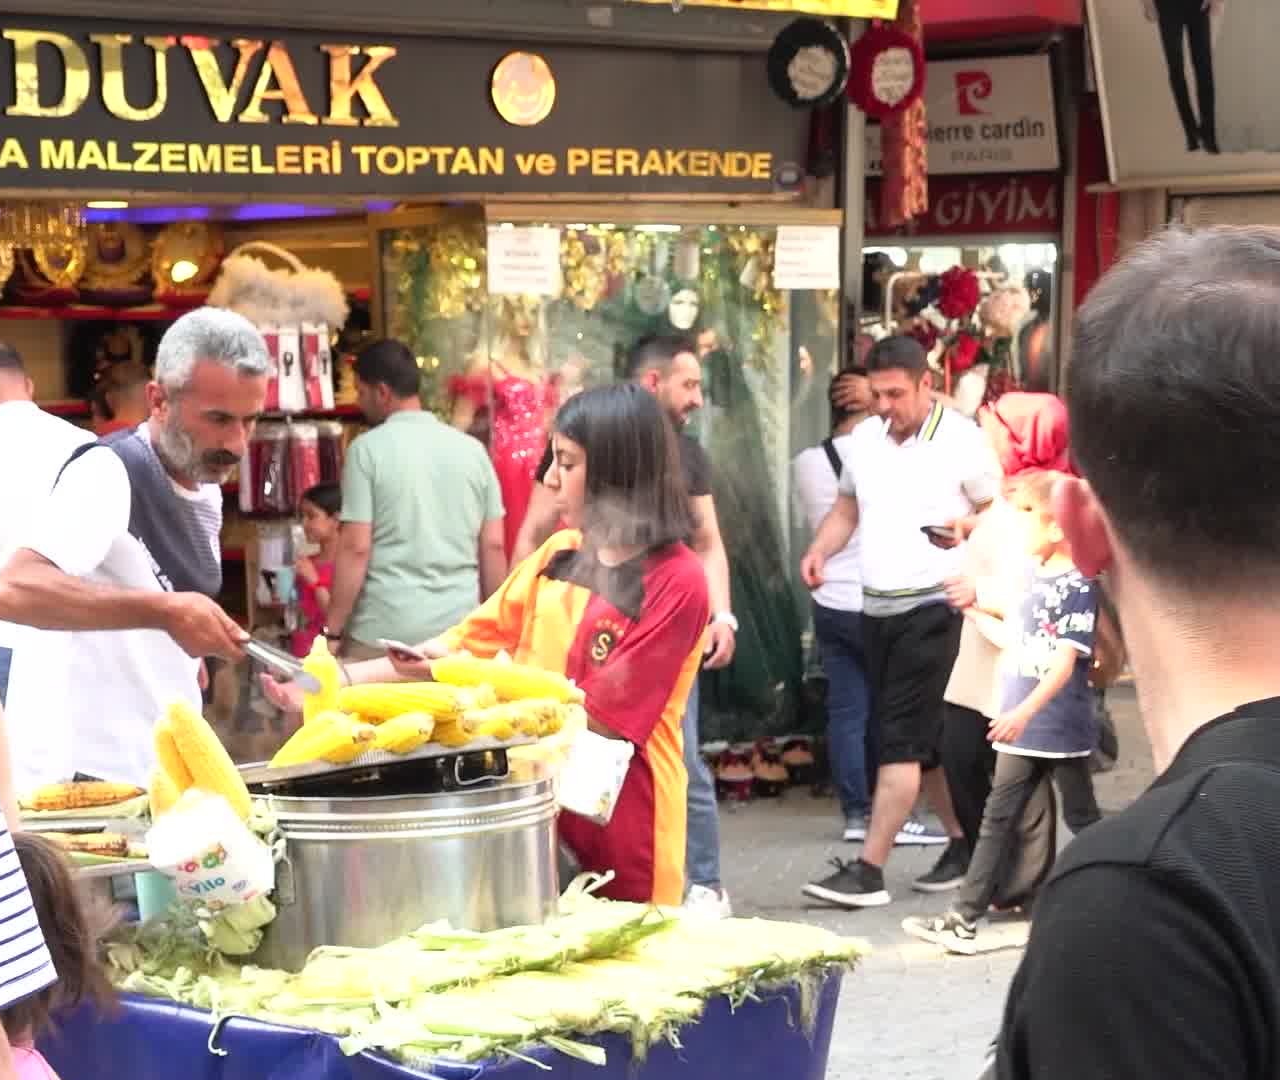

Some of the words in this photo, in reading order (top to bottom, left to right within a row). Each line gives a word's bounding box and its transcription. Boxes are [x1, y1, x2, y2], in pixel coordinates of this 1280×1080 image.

[4, 28, 399, 127] DUVAK
[926, 121, 975, 143] ierre
[981, 117, 1046, 140] cardin
[40, 138, 342, 175] MALZEMELERİ
[352, 144, 504, 177] TOPTAN
[515, 151, 557, 177] ve
[567, 148, 773, 180] PERAKENDE
[934, 179, 1058, 227] GİYİM
